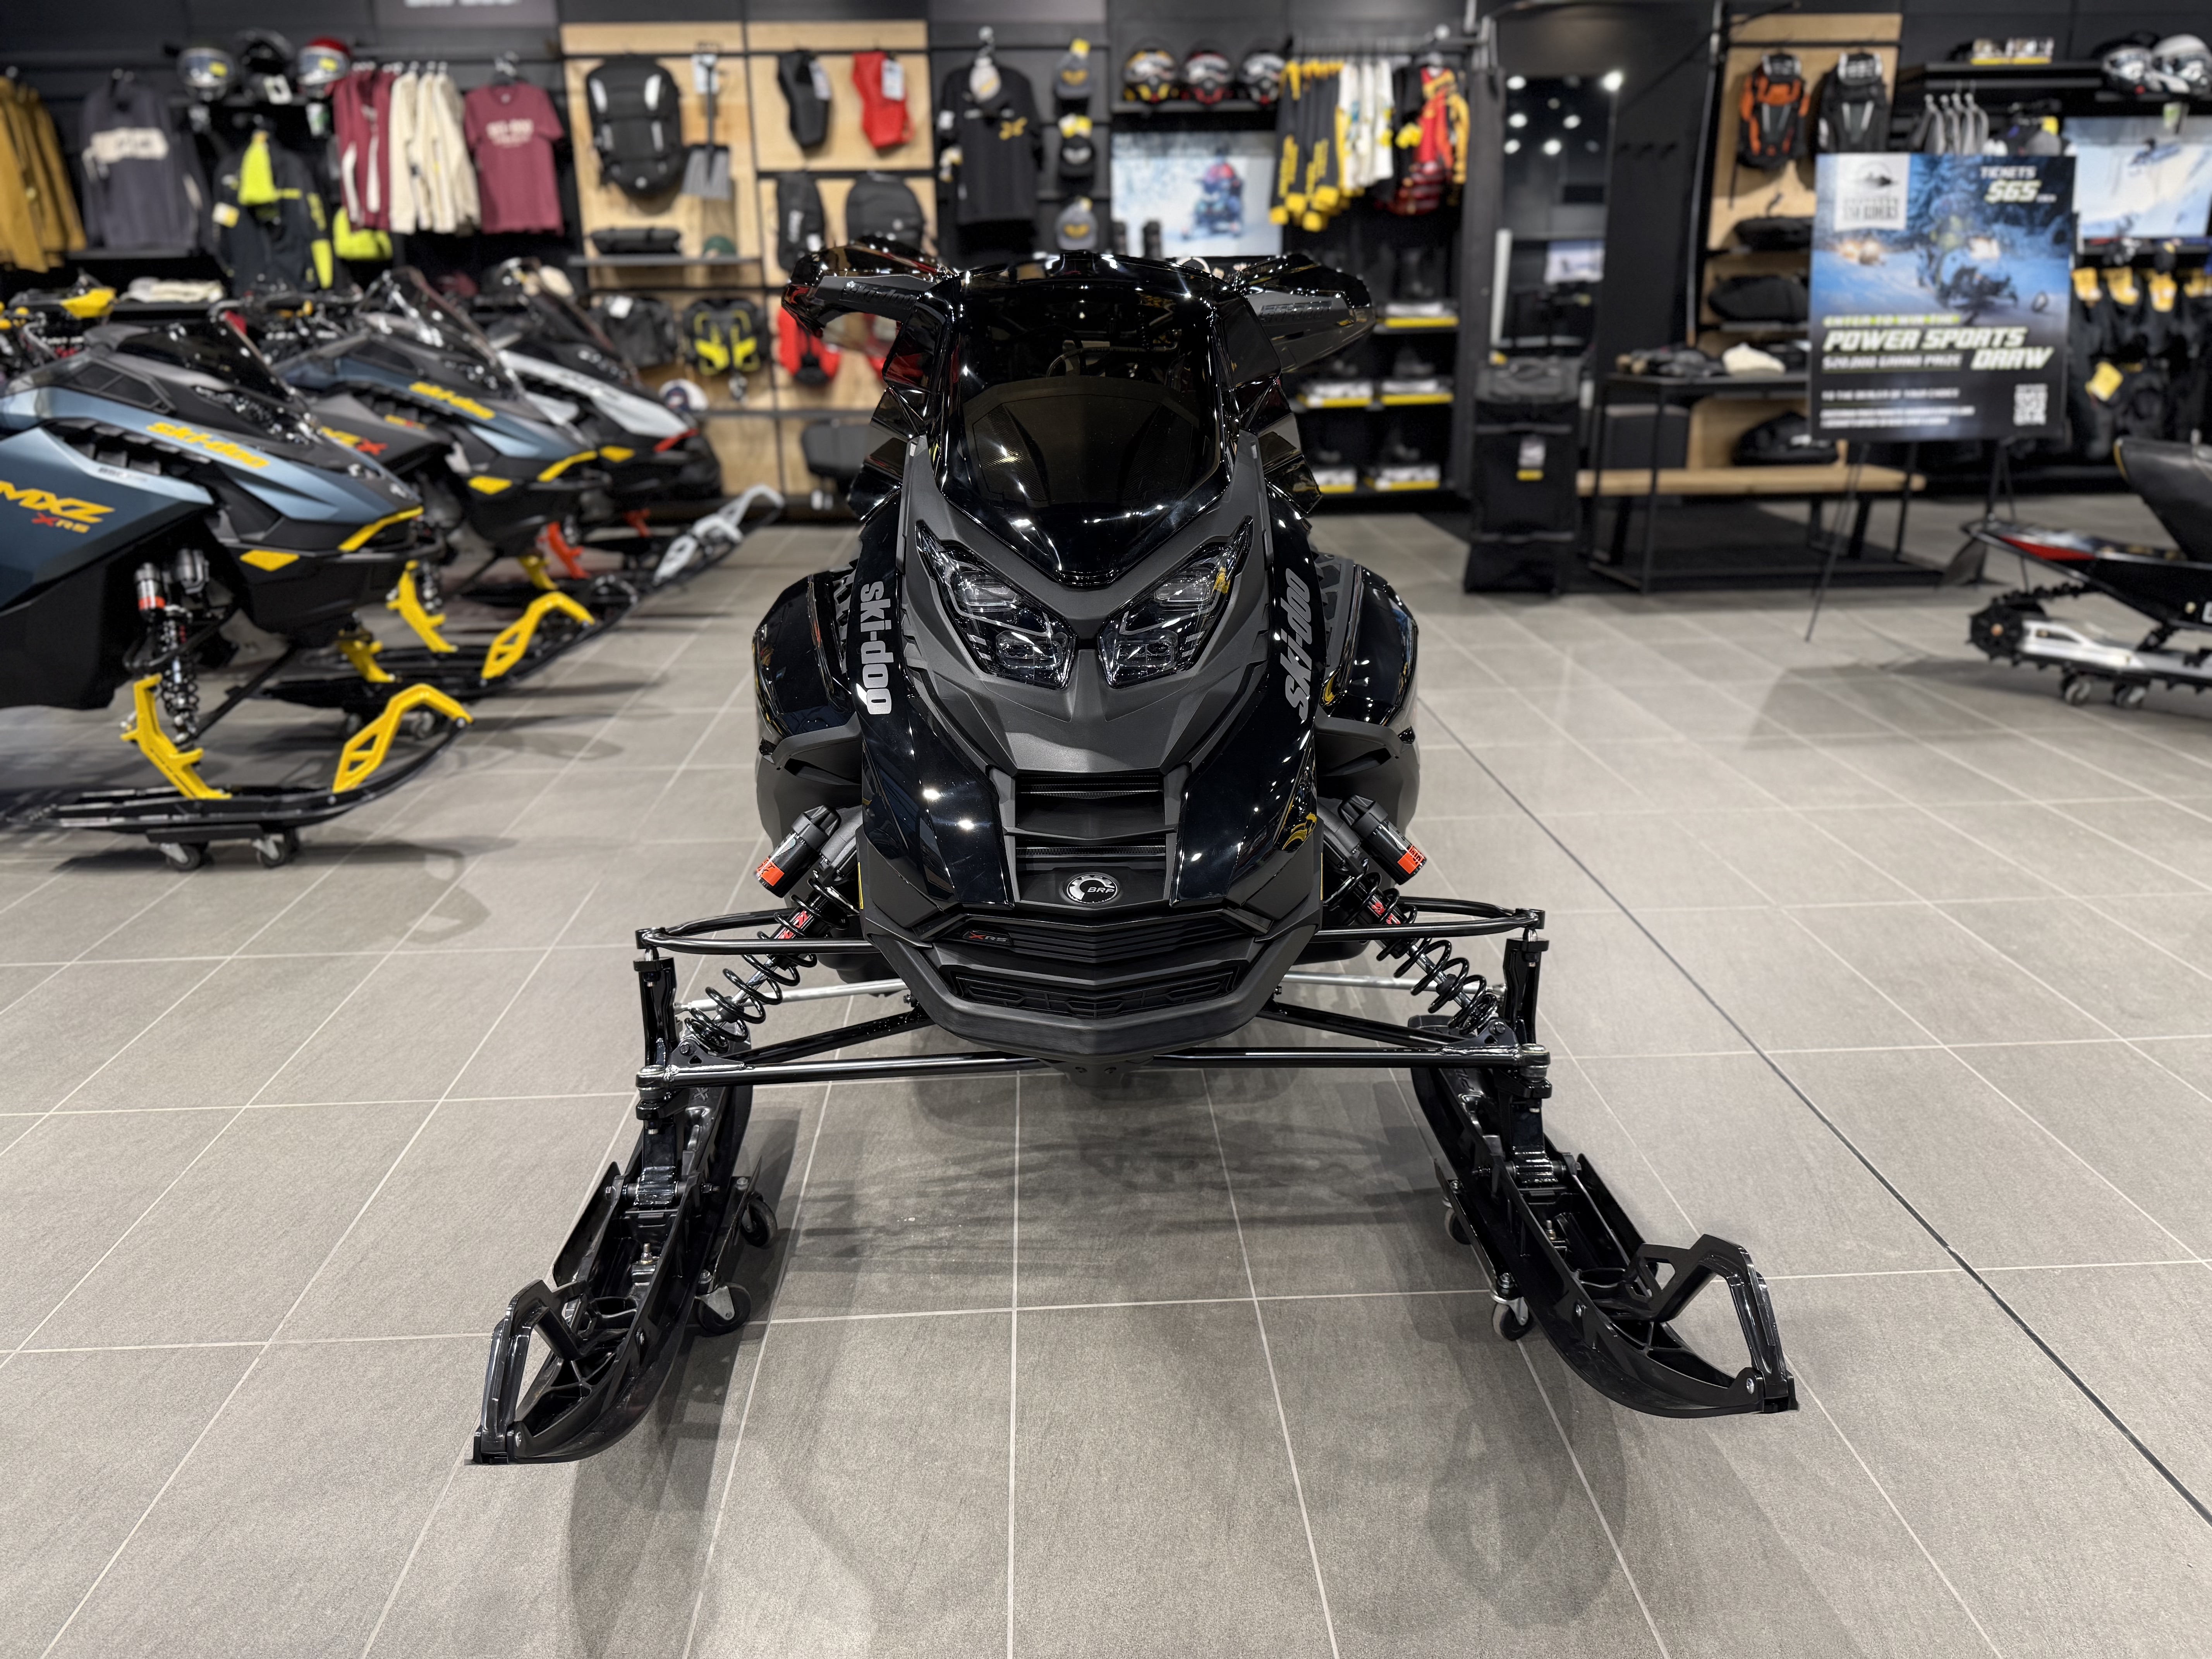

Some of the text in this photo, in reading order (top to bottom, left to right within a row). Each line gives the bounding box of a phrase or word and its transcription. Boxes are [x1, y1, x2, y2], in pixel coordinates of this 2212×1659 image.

[1980, 166, 2037, 179] TICKETS
[1985, 180, 2041, 204] $65
[1823, 327, 2028, 352] POWER SPORTS
[1972, 347, 2054, 370] DRAW
[146, 422, 270, 468] ski-doo
[860, 581, 894, 714] ski-doo
